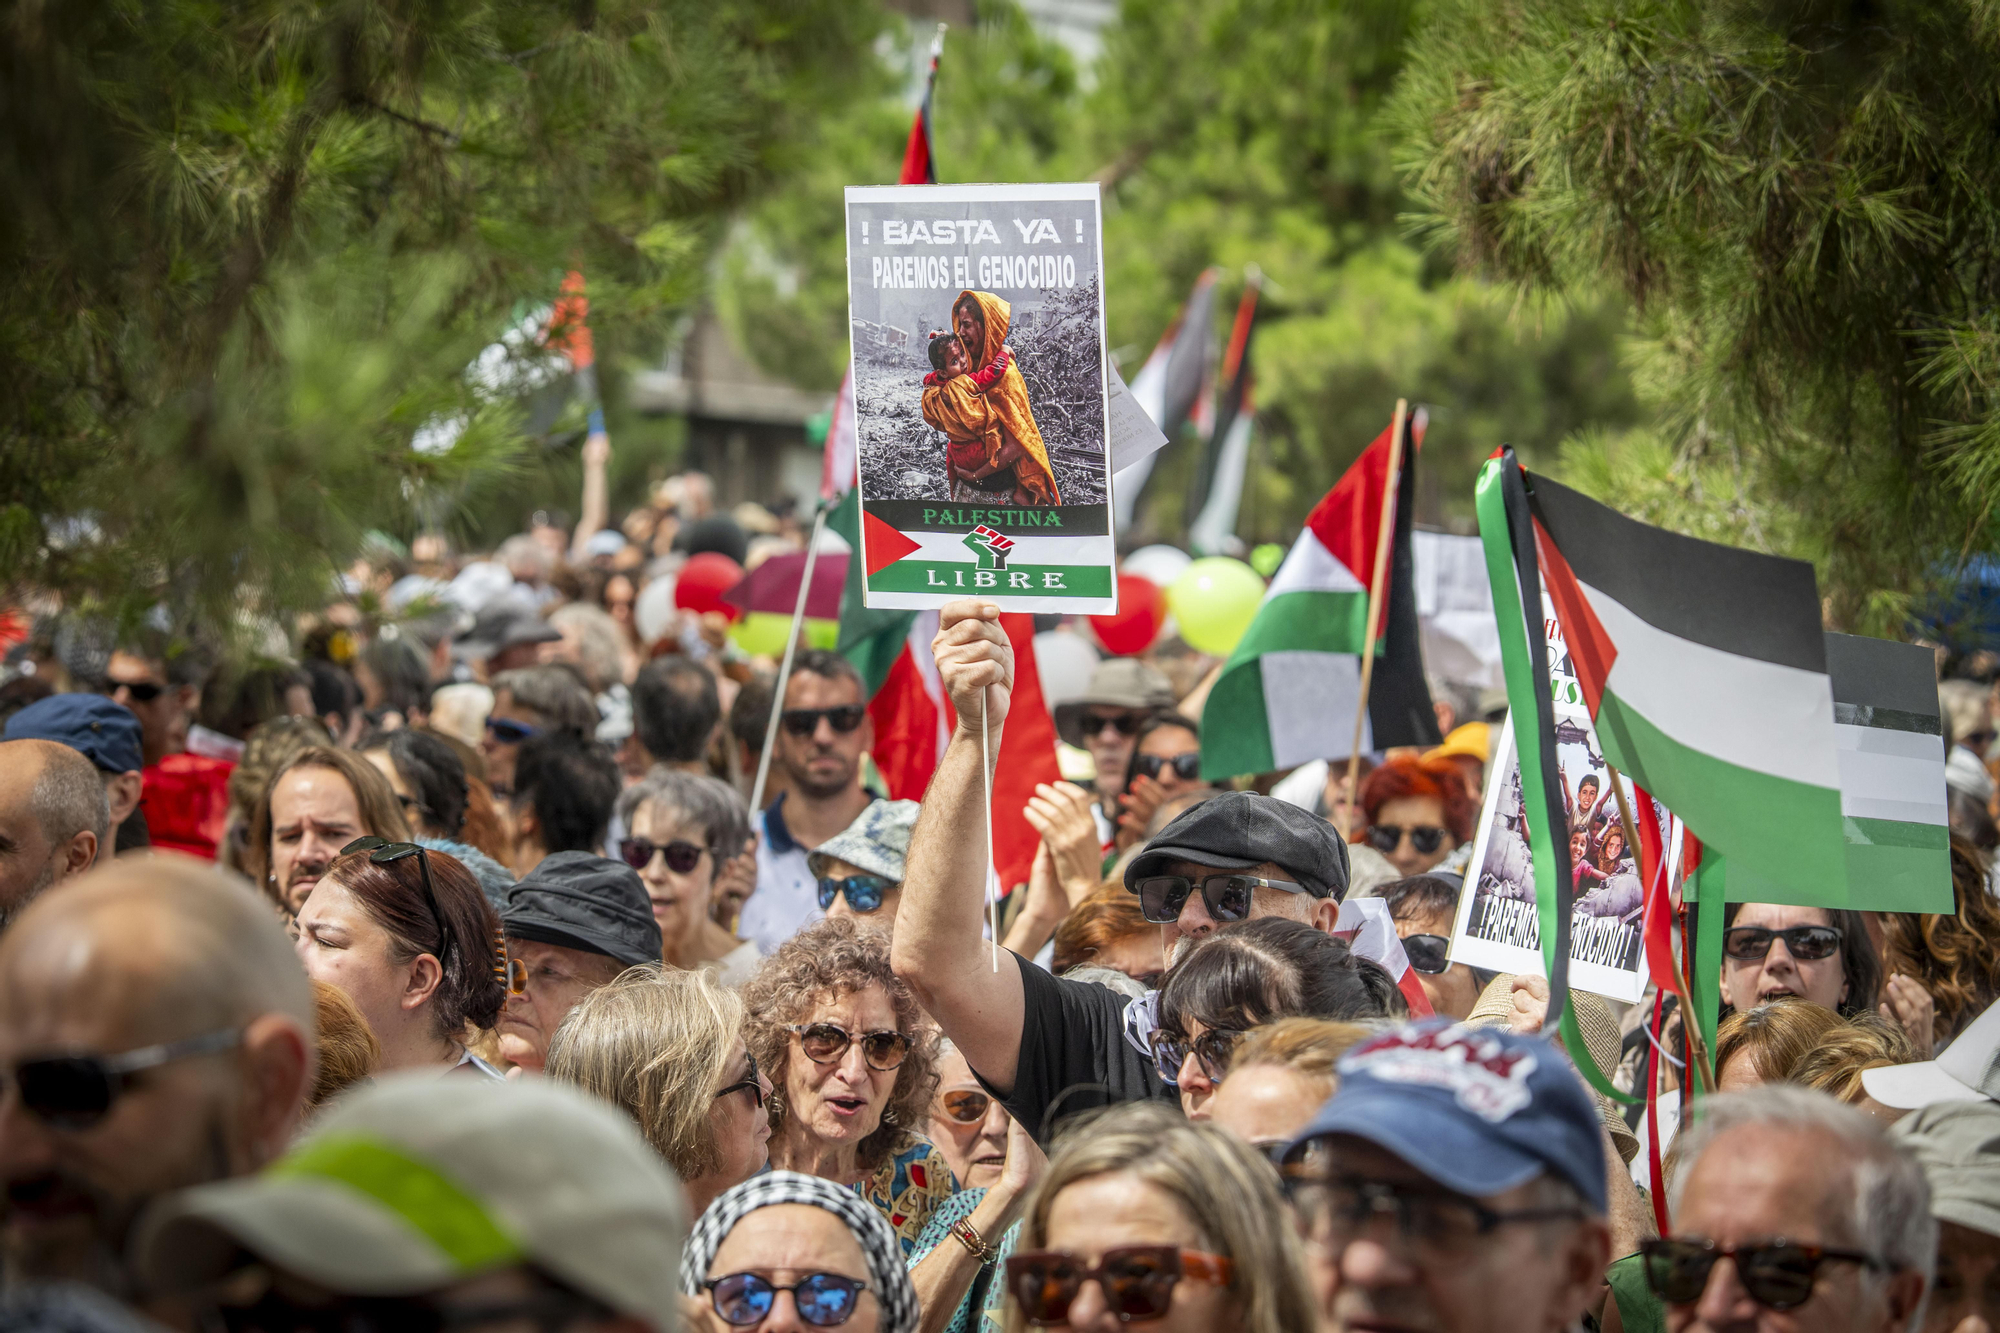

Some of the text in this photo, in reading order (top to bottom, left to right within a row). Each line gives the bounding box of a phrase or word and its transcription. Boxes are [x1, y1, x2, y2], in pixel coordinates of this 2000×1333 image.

[882, 218, 1001, 246] BASTA
[1012, 218, 1062, 244] YA
[1075, 218, 1084, 244] !
[872, 254, 1076, 289] PAREMOS EL GENOCIDIO
[923, 508, 1064, 528] PALESTINA
[926, 569, 1067, 589] LIBRE
[1570, 911, 1626, 969] ENOCIDIO
